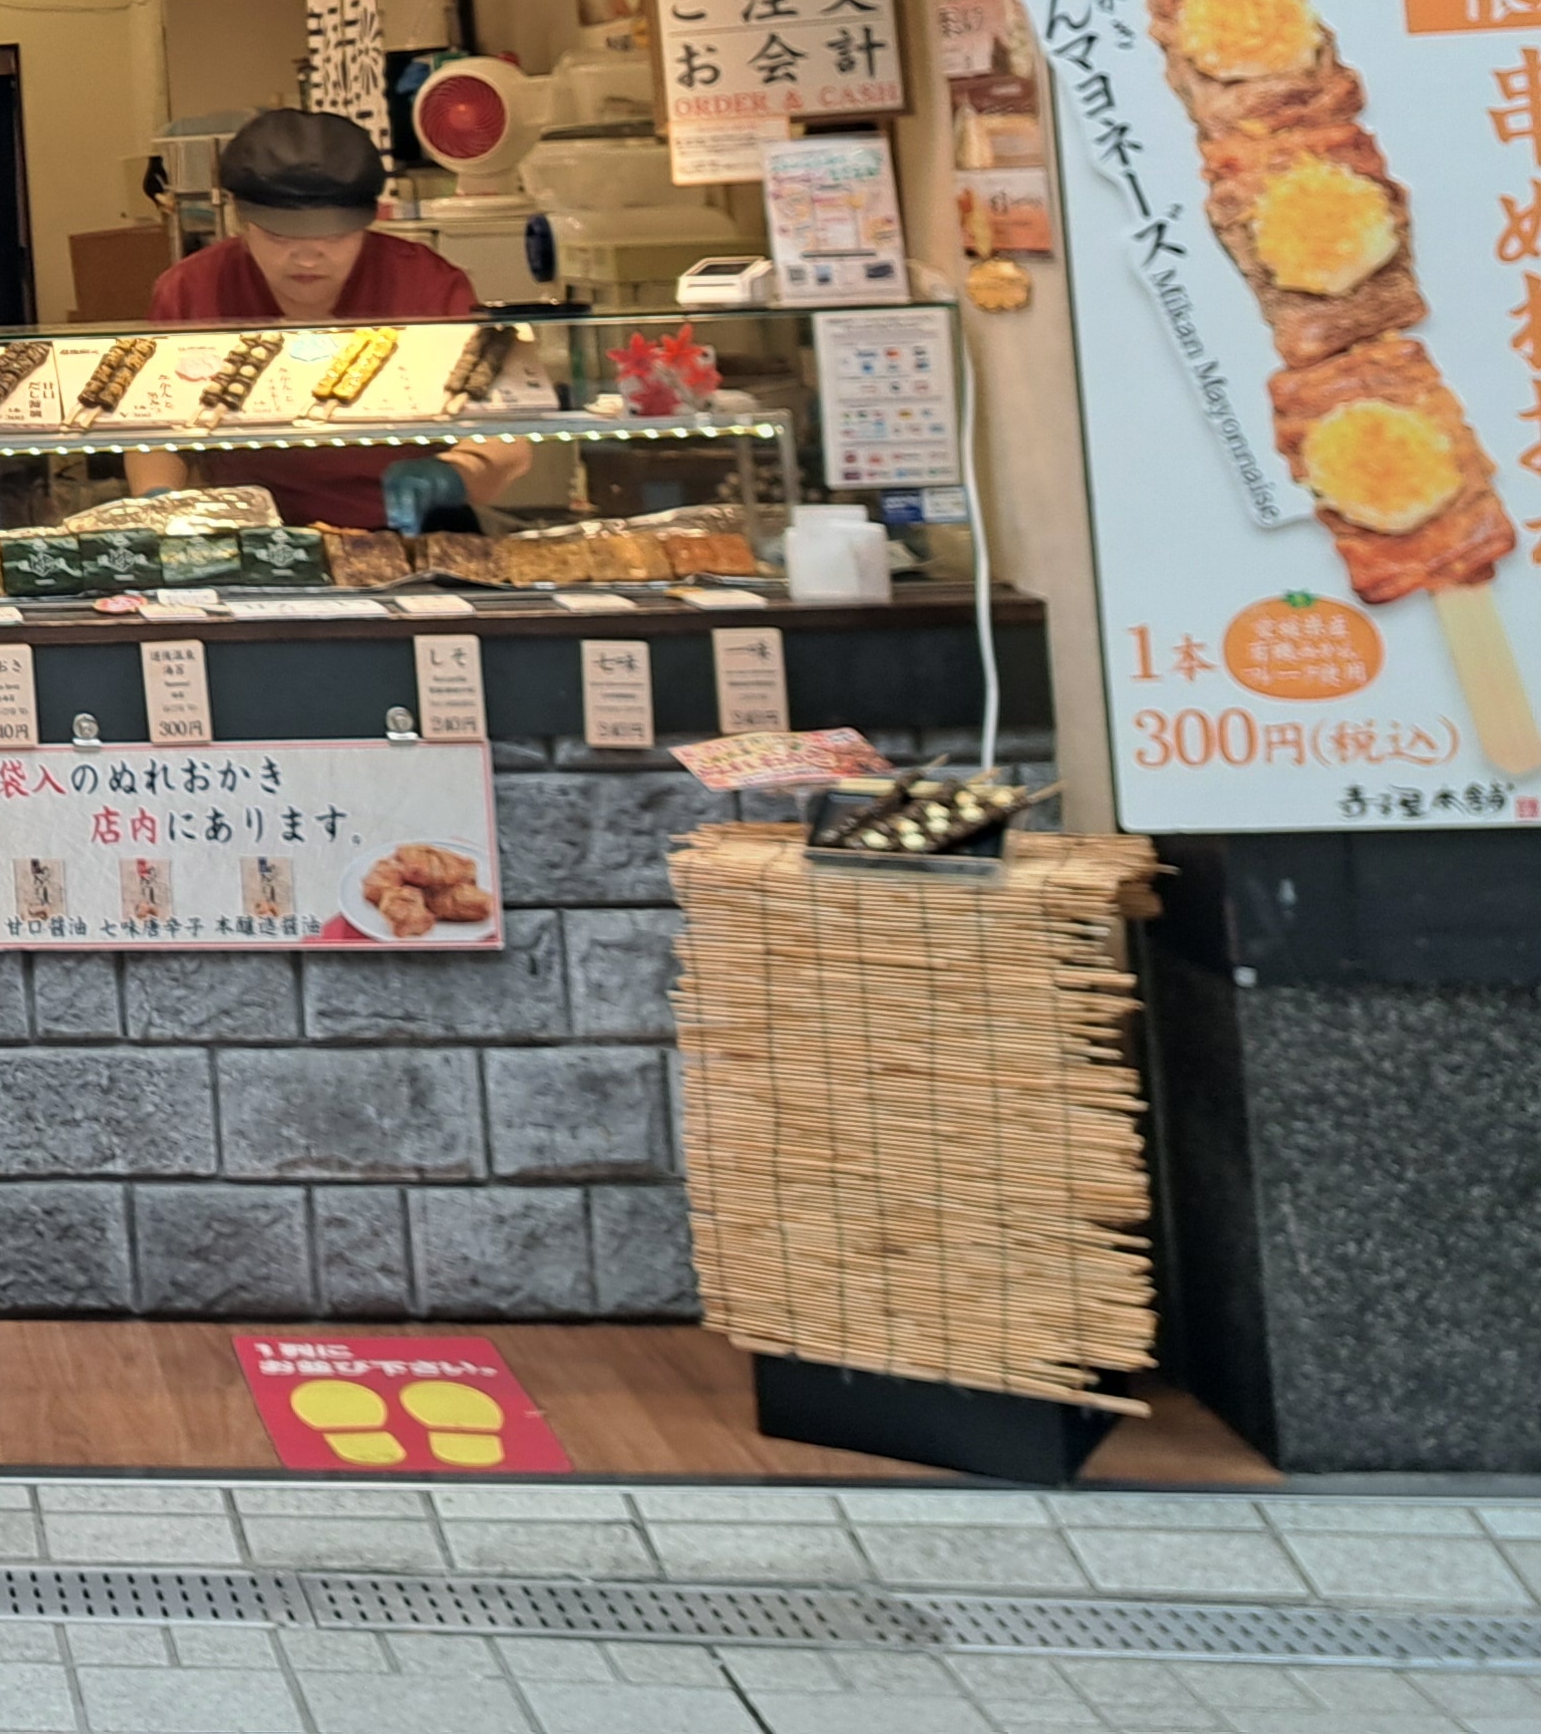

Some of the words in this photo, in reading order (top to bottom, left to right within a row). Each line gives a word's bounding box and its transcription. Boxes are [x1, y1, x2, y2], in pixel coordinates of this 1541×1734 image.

[675, 27, 887, 89] お会計
[674, 94, 768, 115] ORDER
[1152, 266, 1205, 361] Mikan
[1195, 358, 1281, 523] Mayonnaise
[429, 647, 467, 666] しそ
[1127, 624, 1215, 682] 1本
[158, 719, 202, 737] 300円
[1134, 707, 1460, 768] 300円(税込)
[1338, 780, 1515, 820] 寺子屋本舗
[90, 804, 363, 846] 店内にあります。
[5, 916, 88, 938] 甘口醤油
[98, 916, 205, 938] 七味唐辛子
[215, 915, 322, 938] 本醸造醤油
